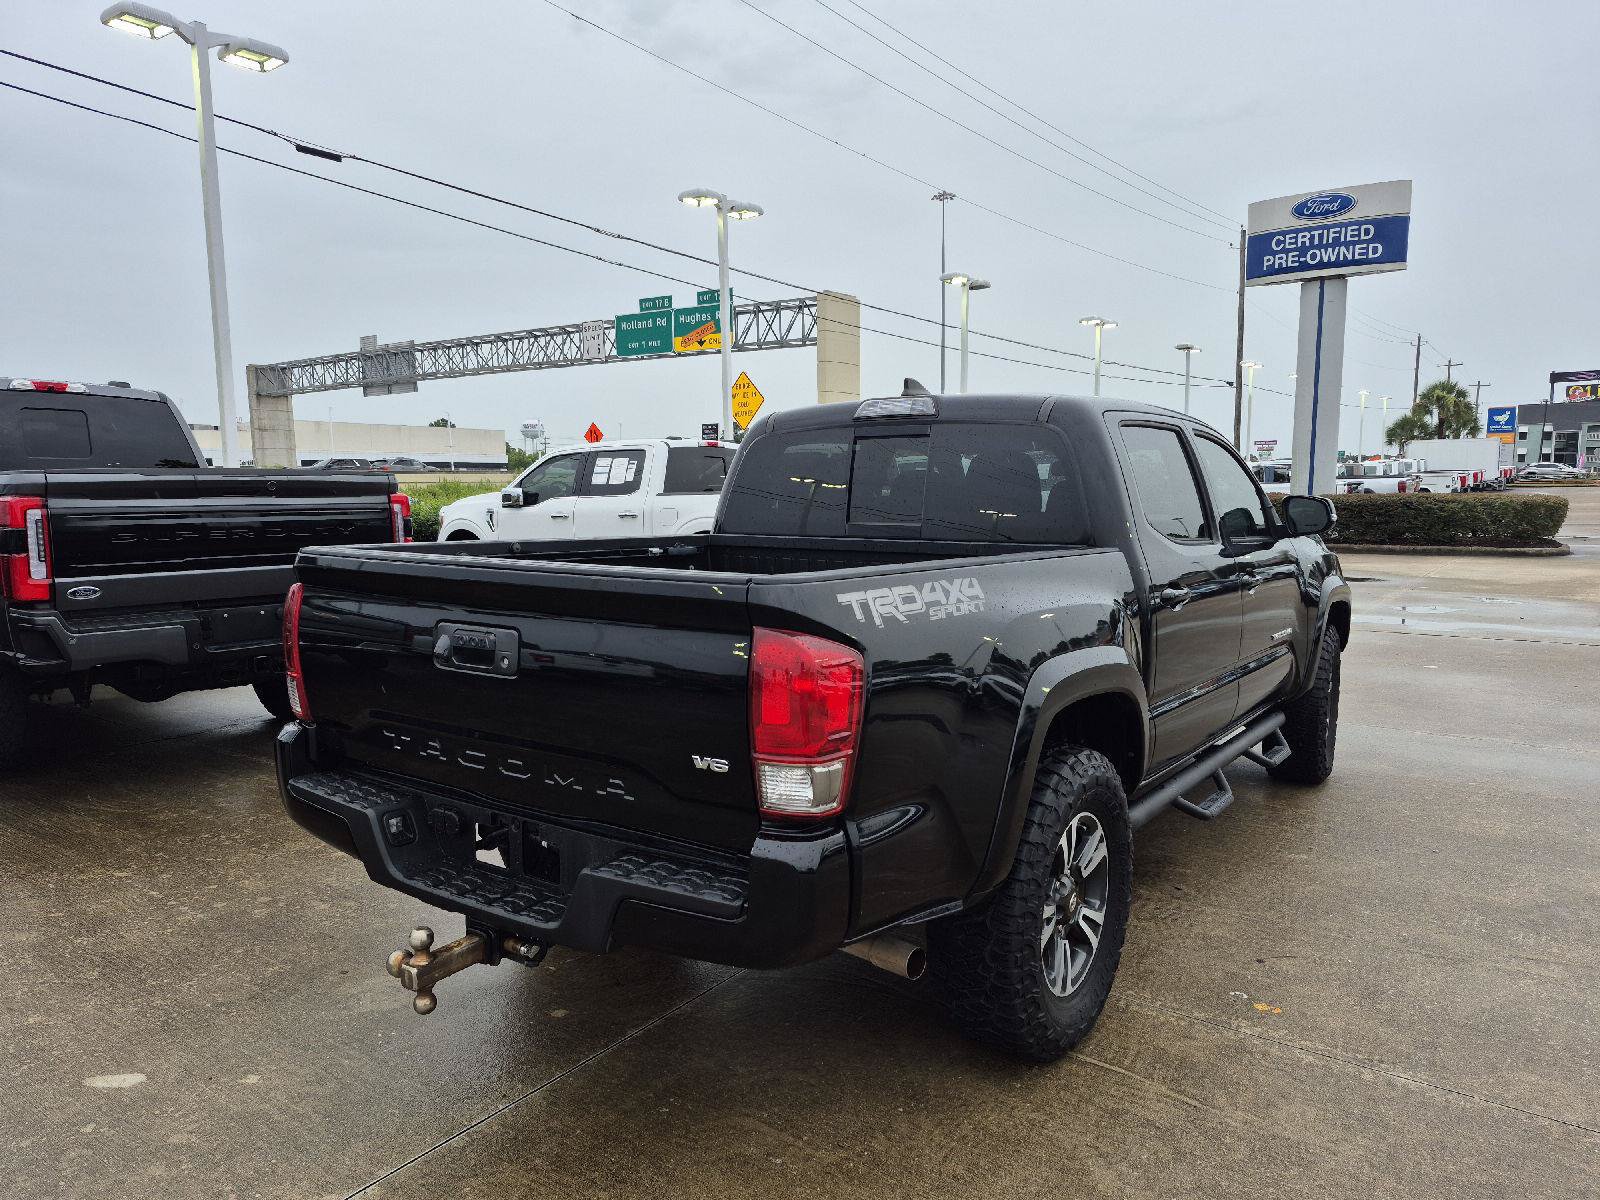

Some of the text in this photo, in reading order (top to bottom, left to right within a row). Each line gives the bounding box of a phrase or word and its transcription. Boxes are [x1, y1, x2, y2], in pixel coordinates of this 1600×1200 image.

[1303, 197, 1342, 215] Ford
[1271, 224, 1375, 251] CERTIFIED
[1263, 243, 1383, 271] PRE-OWNED
[655, 299, 662, 307] 17
[664, 298, 669, 307] B
[621, 317, 667, 331] Holland Rd
[679, 312, 711, 325] Hughes
[583, 325, 602, 333] SPEED
[585, 334, 600, 342] LIMIT
[111, 525, 356, 543] SUPER DUTY
[836, 584, 927, 629] TRD
[929, 600, 986, 621] SPORT
[452, 633, 491, 649] TOYOTA
[381, 729, 636, 802] TACOMA
[691, 754, 730, 774] V6
